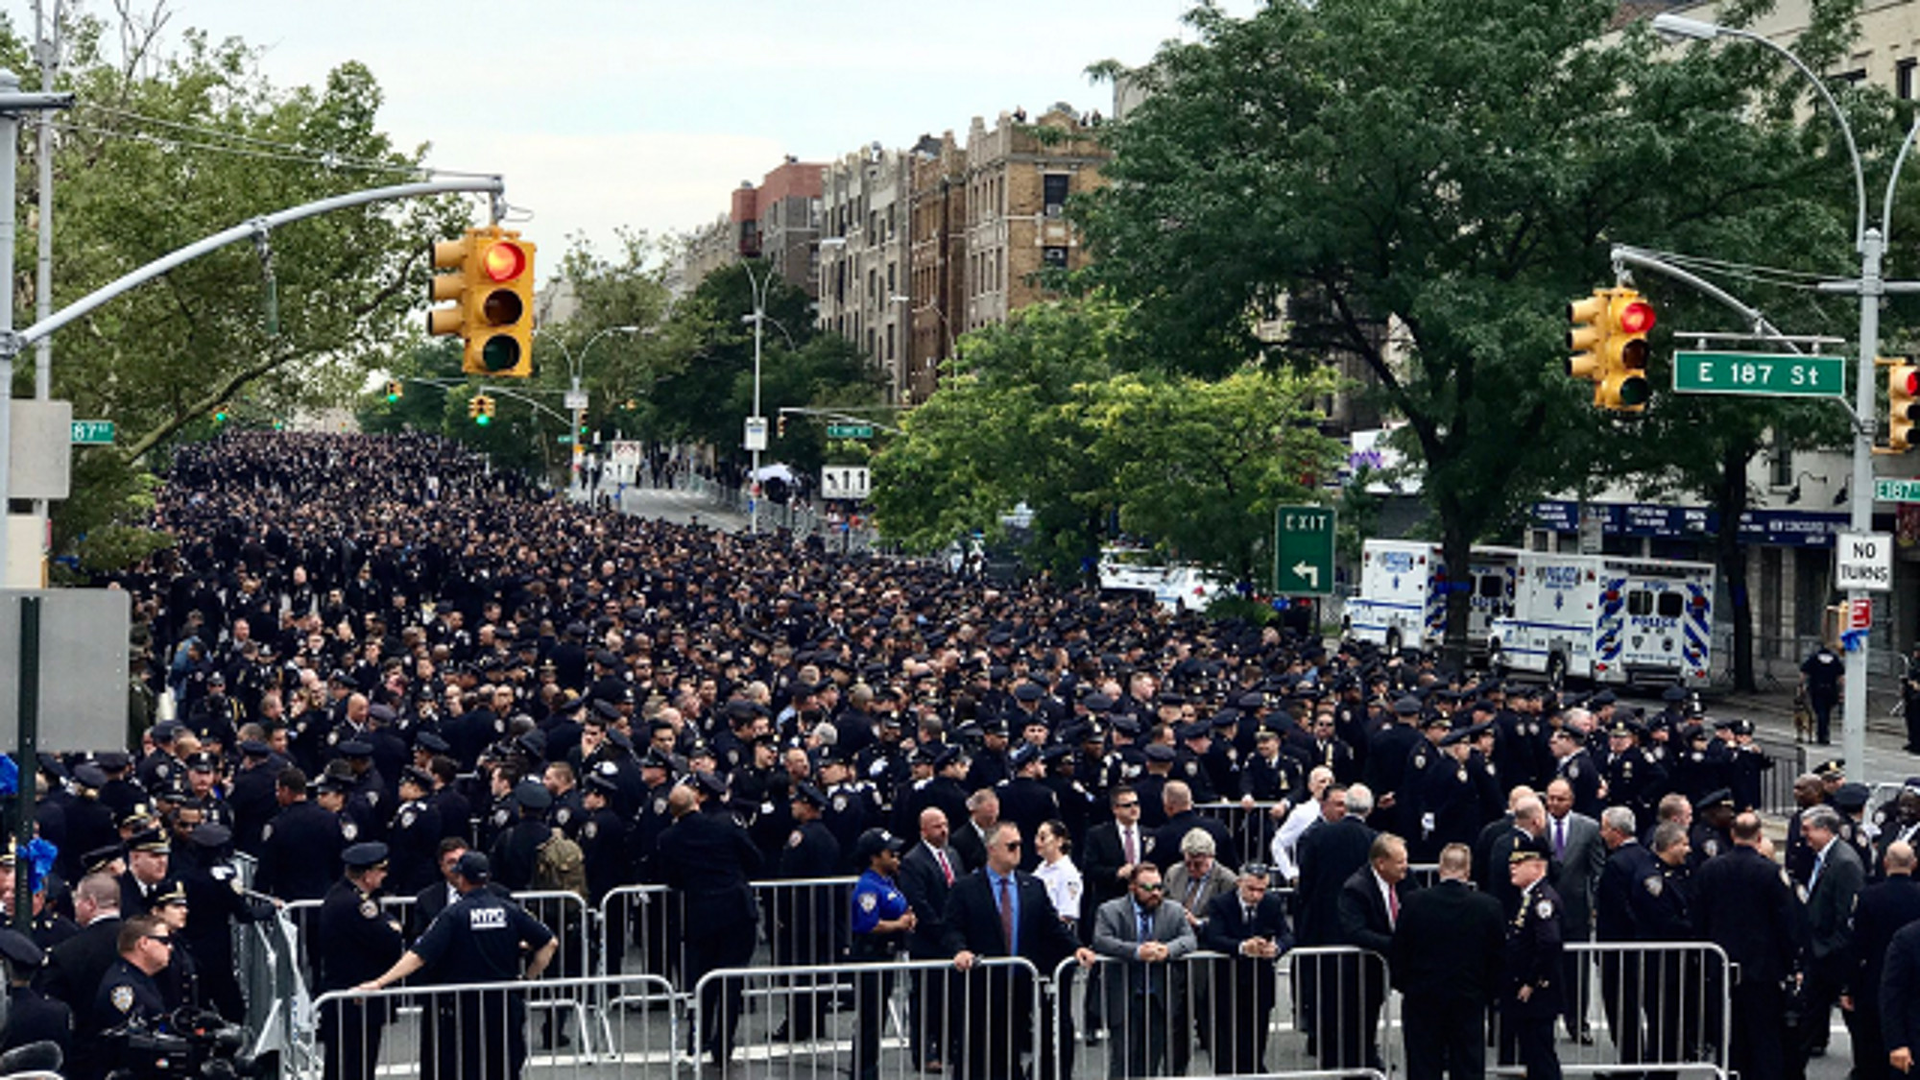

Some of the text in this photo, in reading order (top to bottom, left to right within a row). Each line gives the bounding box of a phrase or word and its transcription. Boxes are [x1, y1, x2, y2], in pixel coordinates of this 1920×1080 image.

[1700, 363, 1819, 385] E 187 St
[1286, 514, 1327, 531] EXIT
[1853, 542, 1876, 559] NO
[1841, 563, 1888, 582] TURNS
[1631, 617, 1678, 629] POLICE
[470, 908, 505, 923] NYPD
